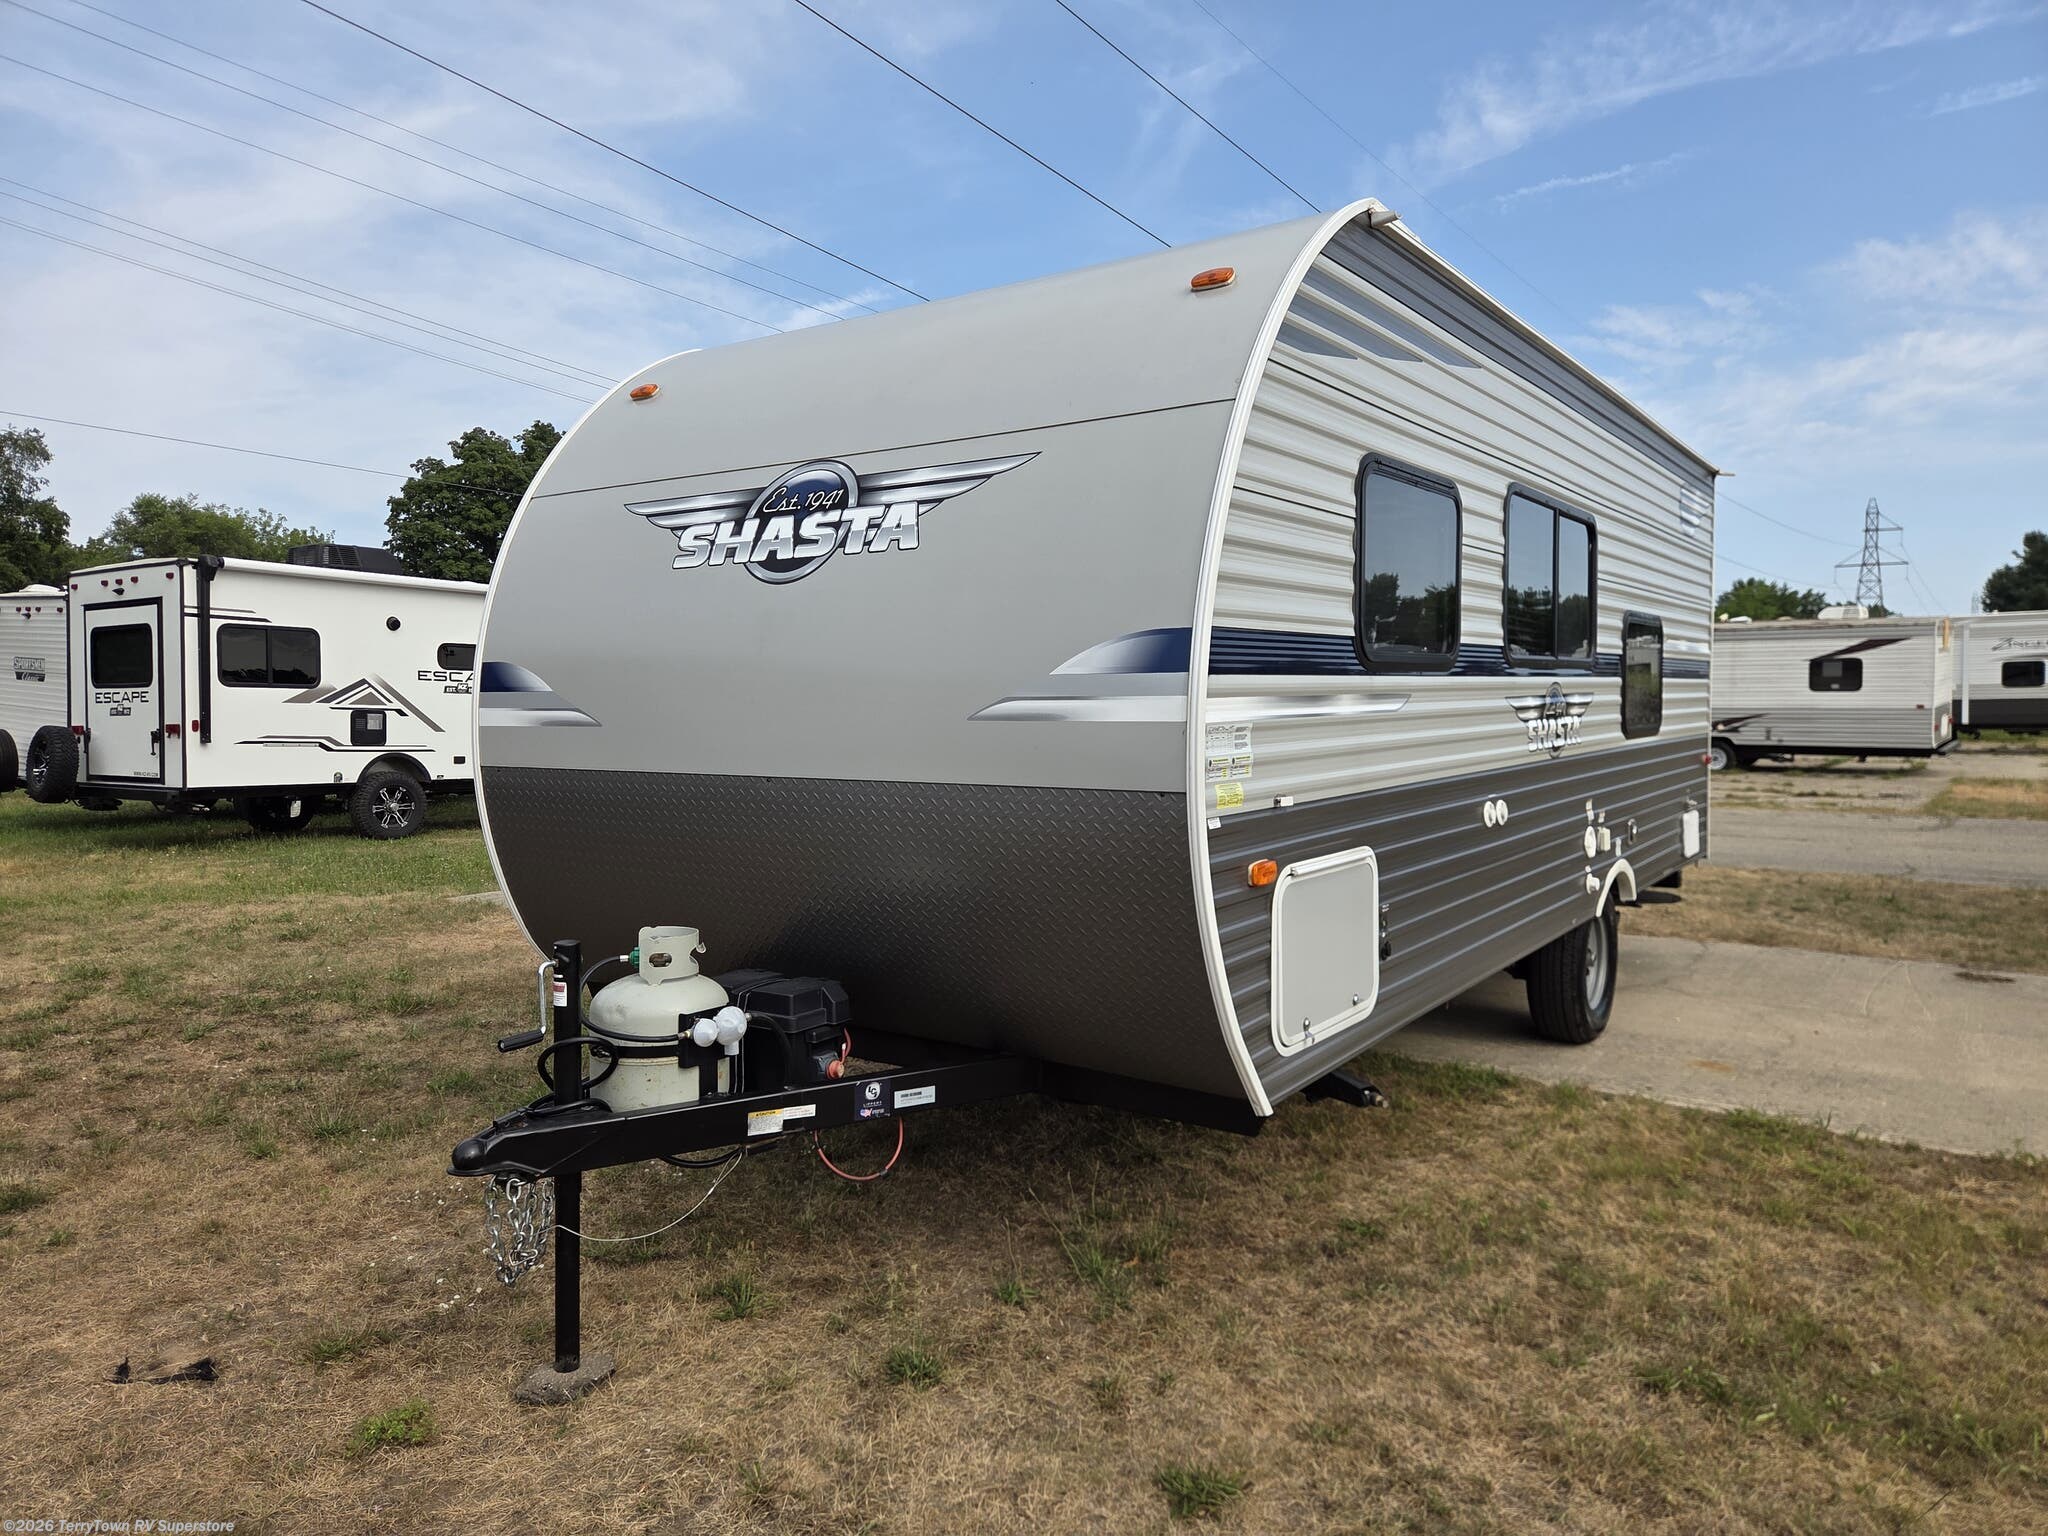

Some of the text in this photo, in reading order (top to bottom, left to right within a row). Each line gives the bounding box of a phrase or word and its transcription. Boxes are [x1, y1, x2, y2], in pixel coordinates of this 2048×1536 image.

[762, 488, 843, 512] Est. 1941
[672, 501, 919, 570] SHASTA
[95, 691, 149, 703] ESCAPE
[1527, 715, 1582, 752] SHASTA
